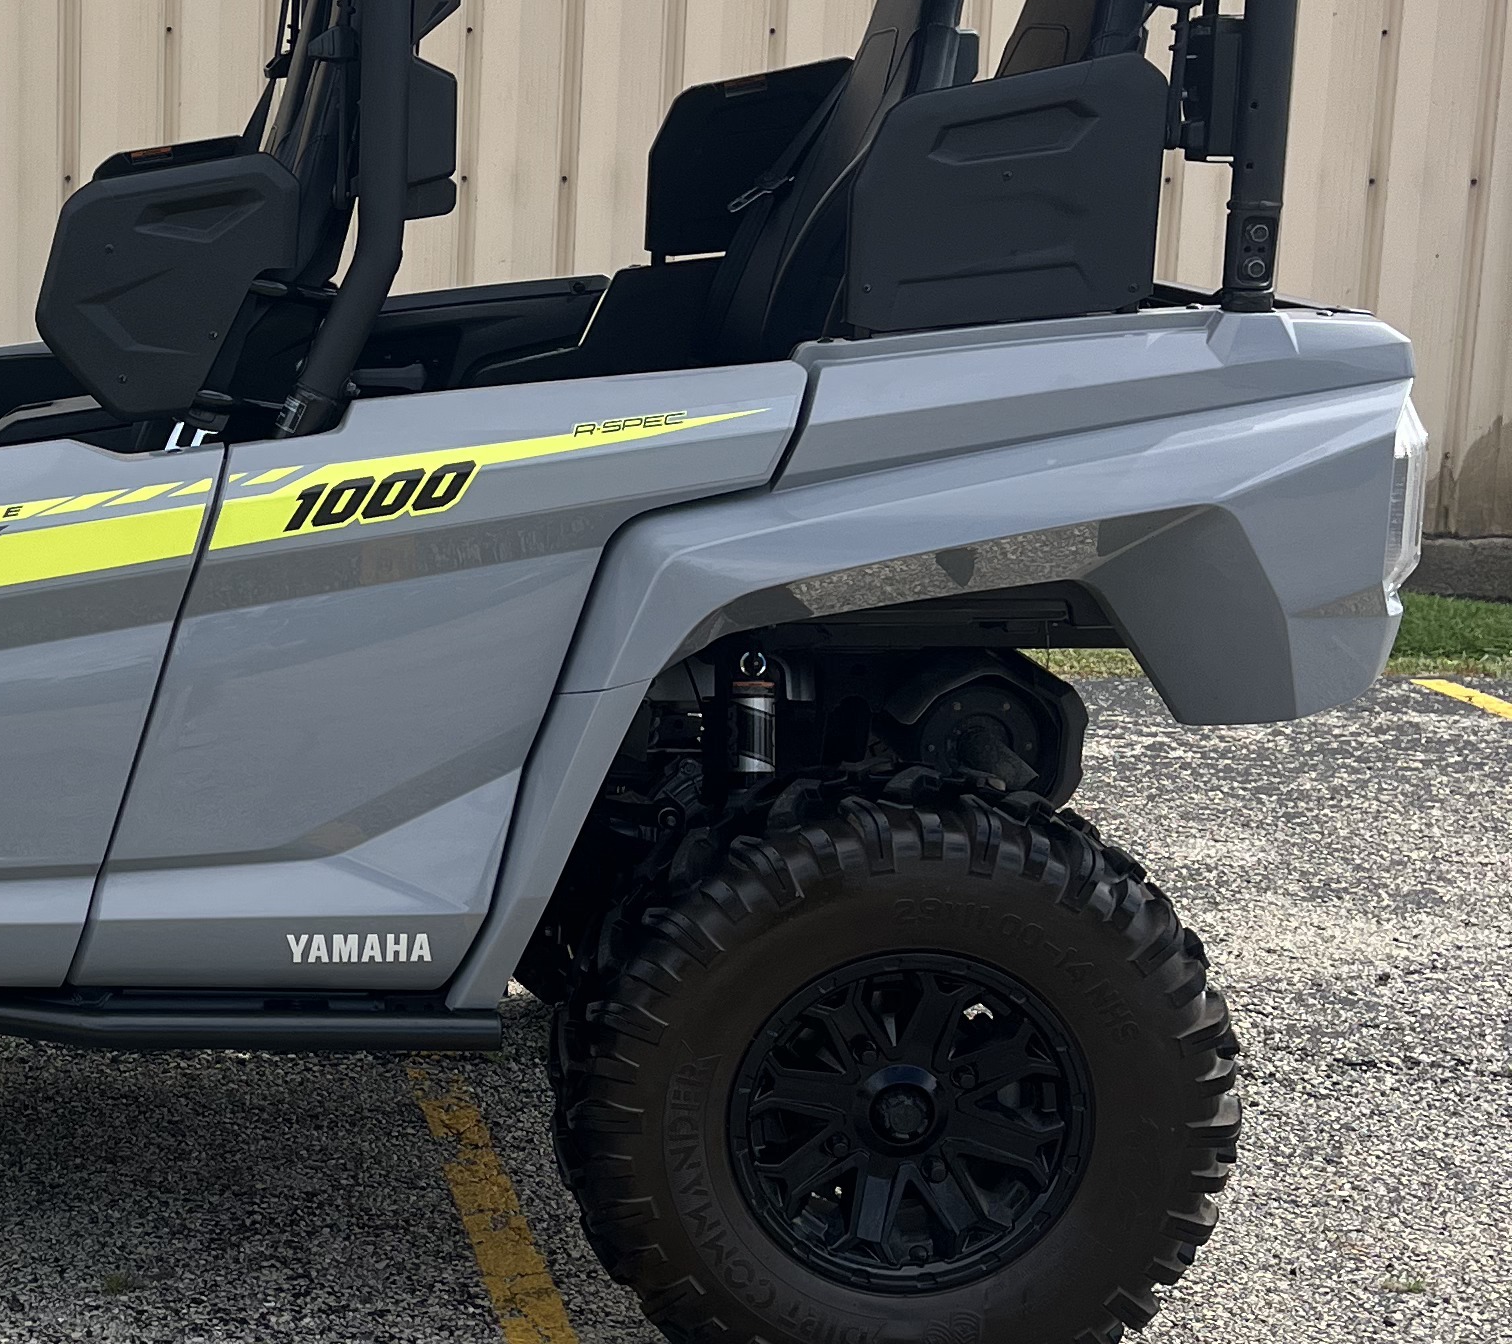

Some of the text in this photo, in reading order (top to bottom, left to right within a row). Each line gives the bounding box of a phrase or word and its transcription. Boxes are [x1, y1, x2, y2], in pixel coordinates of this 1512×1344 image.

[573, 412, 687, 438] R-SPEC
[283, 460, 476, 532] 1000
[286, 933, 432, 963] YAMAHA
[666, 1062, 776, 1309] COMMANDER
